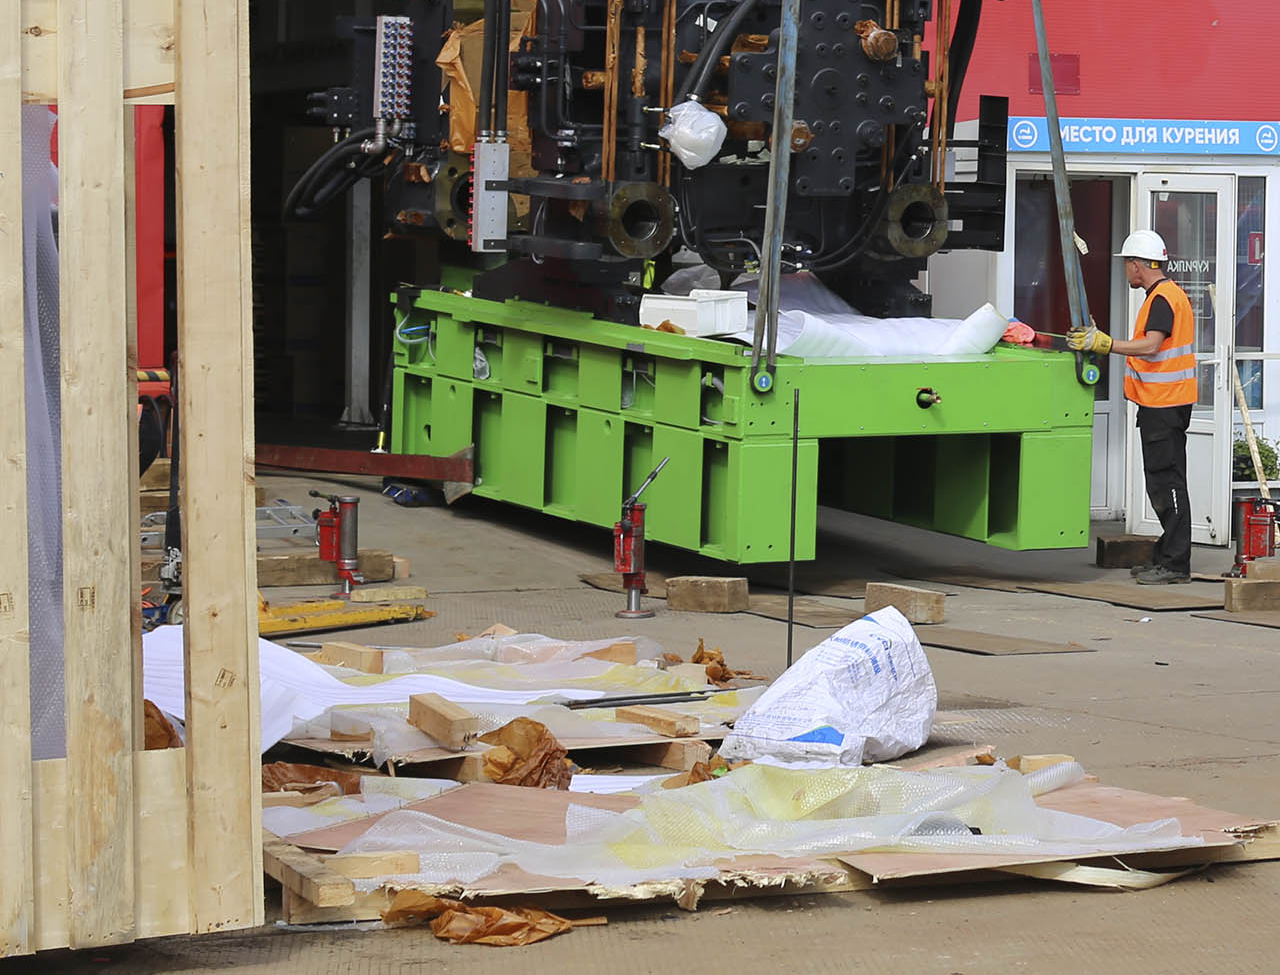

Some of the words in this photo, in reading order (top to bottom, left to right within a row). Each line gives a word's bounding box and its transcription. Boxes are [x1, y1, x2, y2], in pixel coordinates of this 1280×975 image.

[1059, 125, 1117, 143] МЕСТО
[1120, 126, 1158, 146] ДЛЯ
[1161, 127, 1240, 145] КУРЕНИЯ
